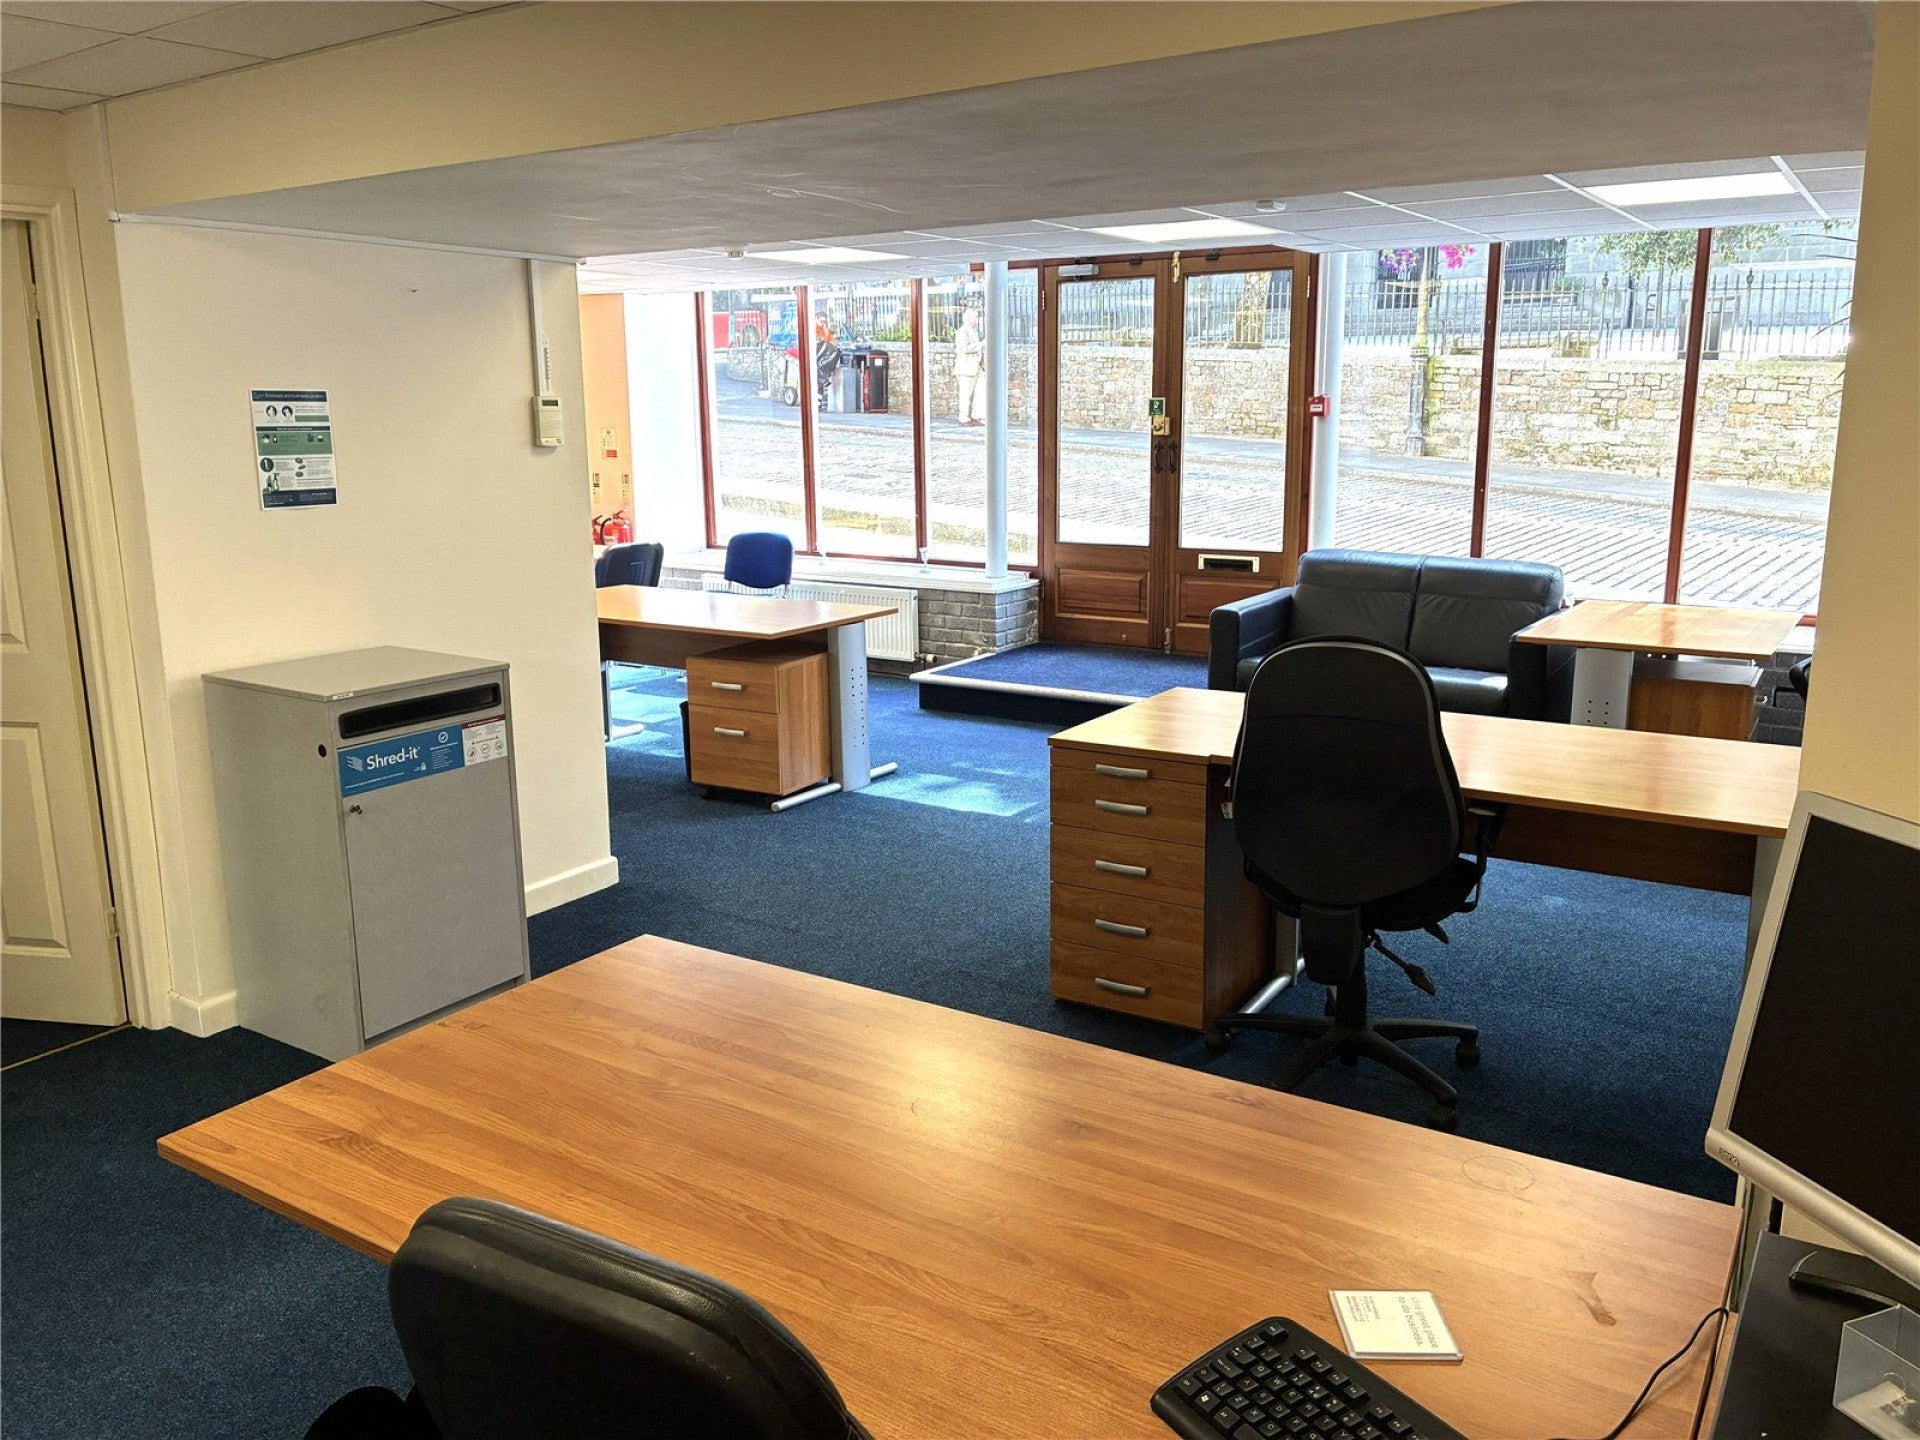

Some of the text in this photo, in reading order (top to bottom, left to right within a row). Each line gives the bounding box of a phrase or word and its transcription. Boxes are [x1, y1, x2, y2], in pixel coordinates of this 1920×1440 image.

[366, 746, 419, 770] Shred-it
[1415, 1311, 1431, 1329] great
[1424, 1329, 1438, 1348] place
